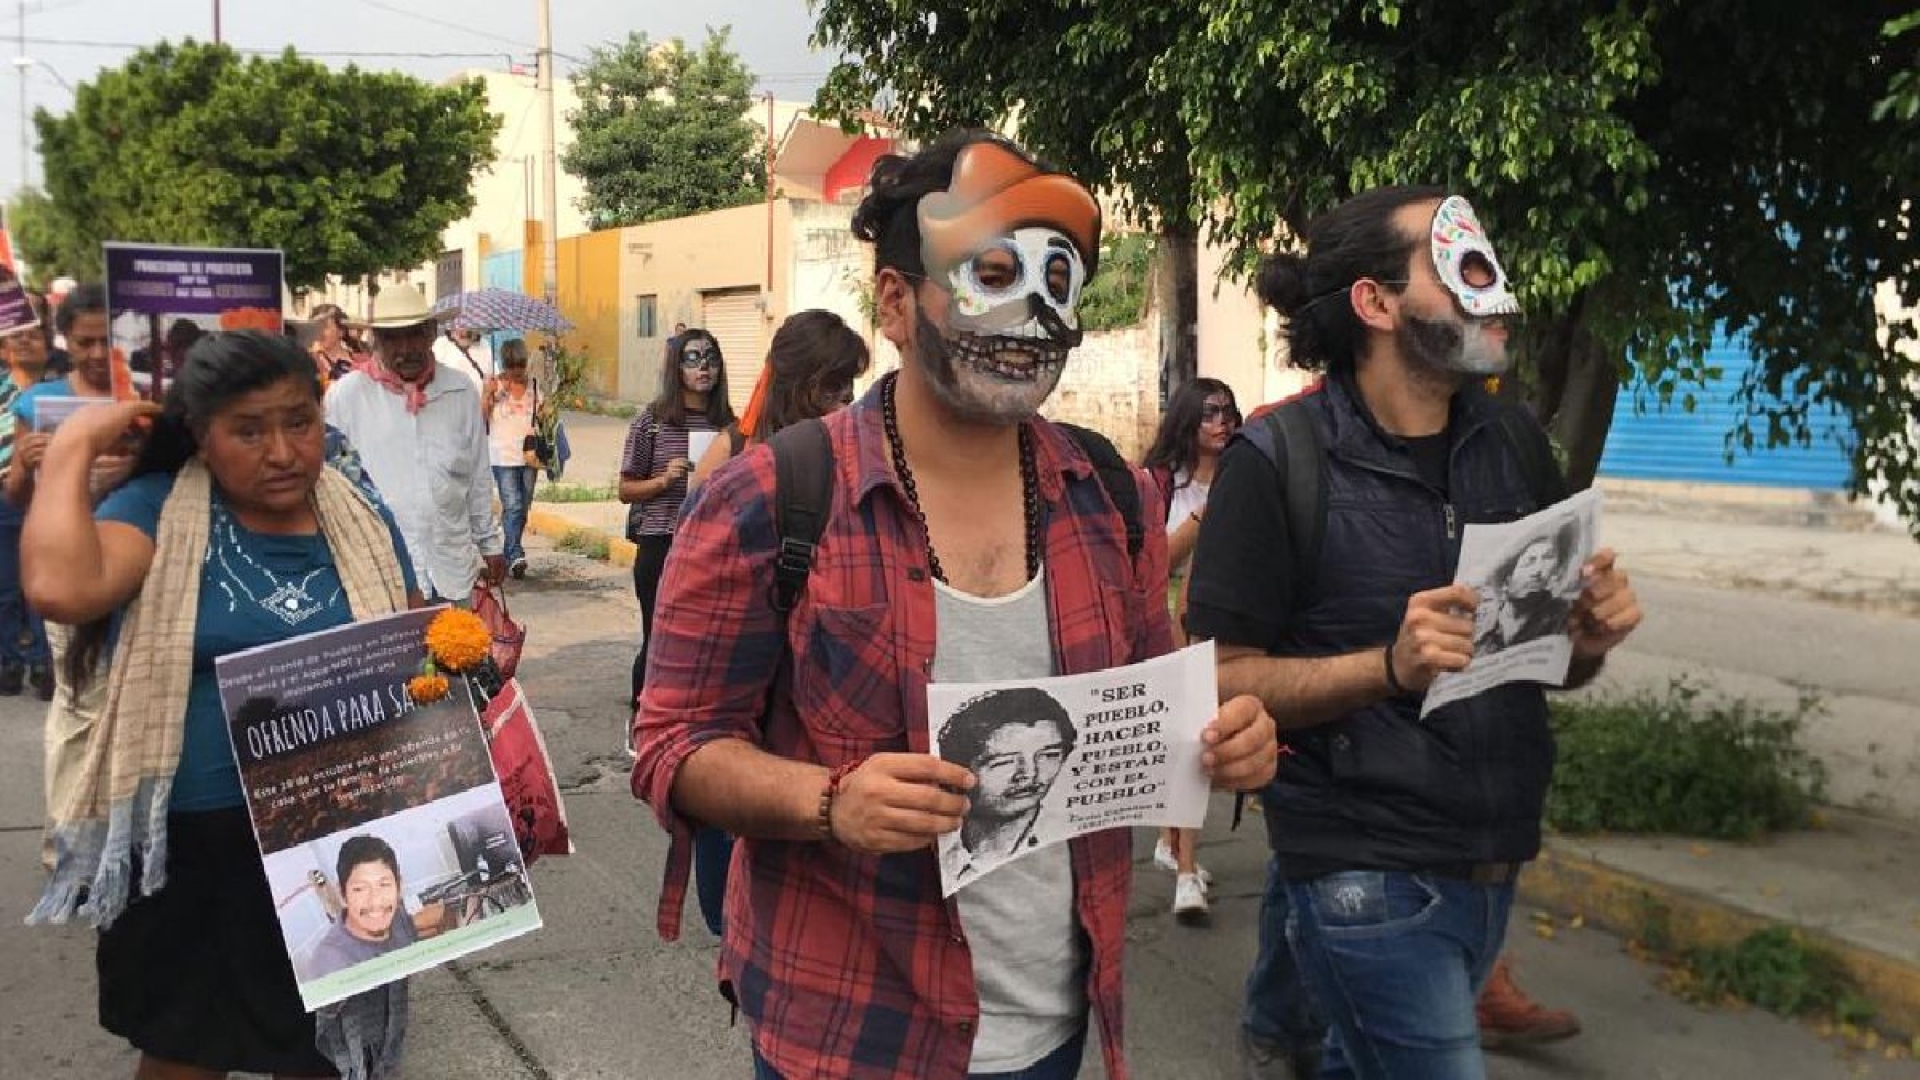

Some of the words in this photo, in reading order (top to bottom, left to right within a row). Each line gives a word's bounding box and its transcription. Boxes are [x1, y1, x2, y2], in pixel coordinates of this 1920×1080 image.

[246, 704, 336, 761] OFRENDA
[337, 689, 386, 732] PARA
[1084, 699, 1170, 729] PUEBLO,
[1084, 720, 1161, 745] HACER
[1093, 753, 1166, 775] ESTAR
[1073, 776, 1116, 792] CON
[1124, 772, 1148, 785] EL
